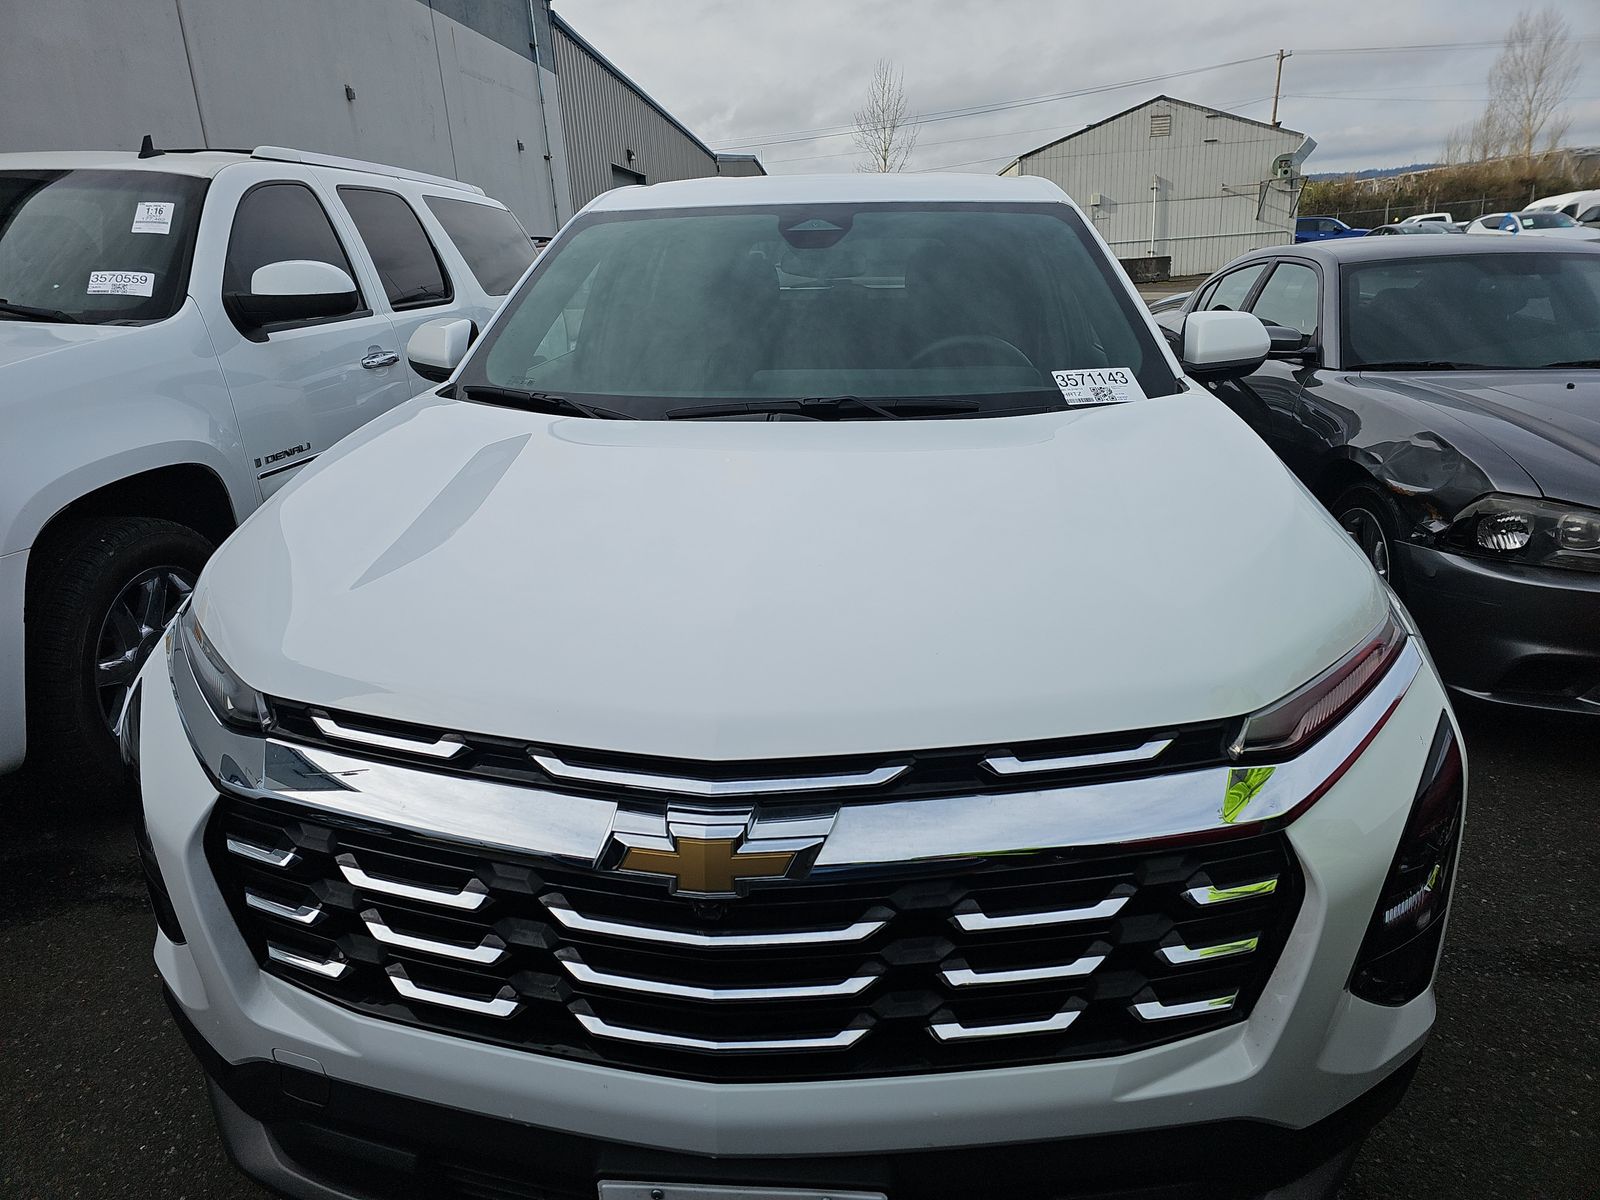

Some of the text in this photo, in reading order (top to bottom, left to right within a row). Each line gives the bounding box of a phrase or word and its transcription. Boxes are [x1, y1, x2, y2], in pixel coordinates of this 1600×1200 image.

[146, 207, 164, 215] 1:16
[90, 273, 148, 285] 3570559
[1055, 371, 1129, 388] 3571143
[264, 442, 311, 465] DENALI
